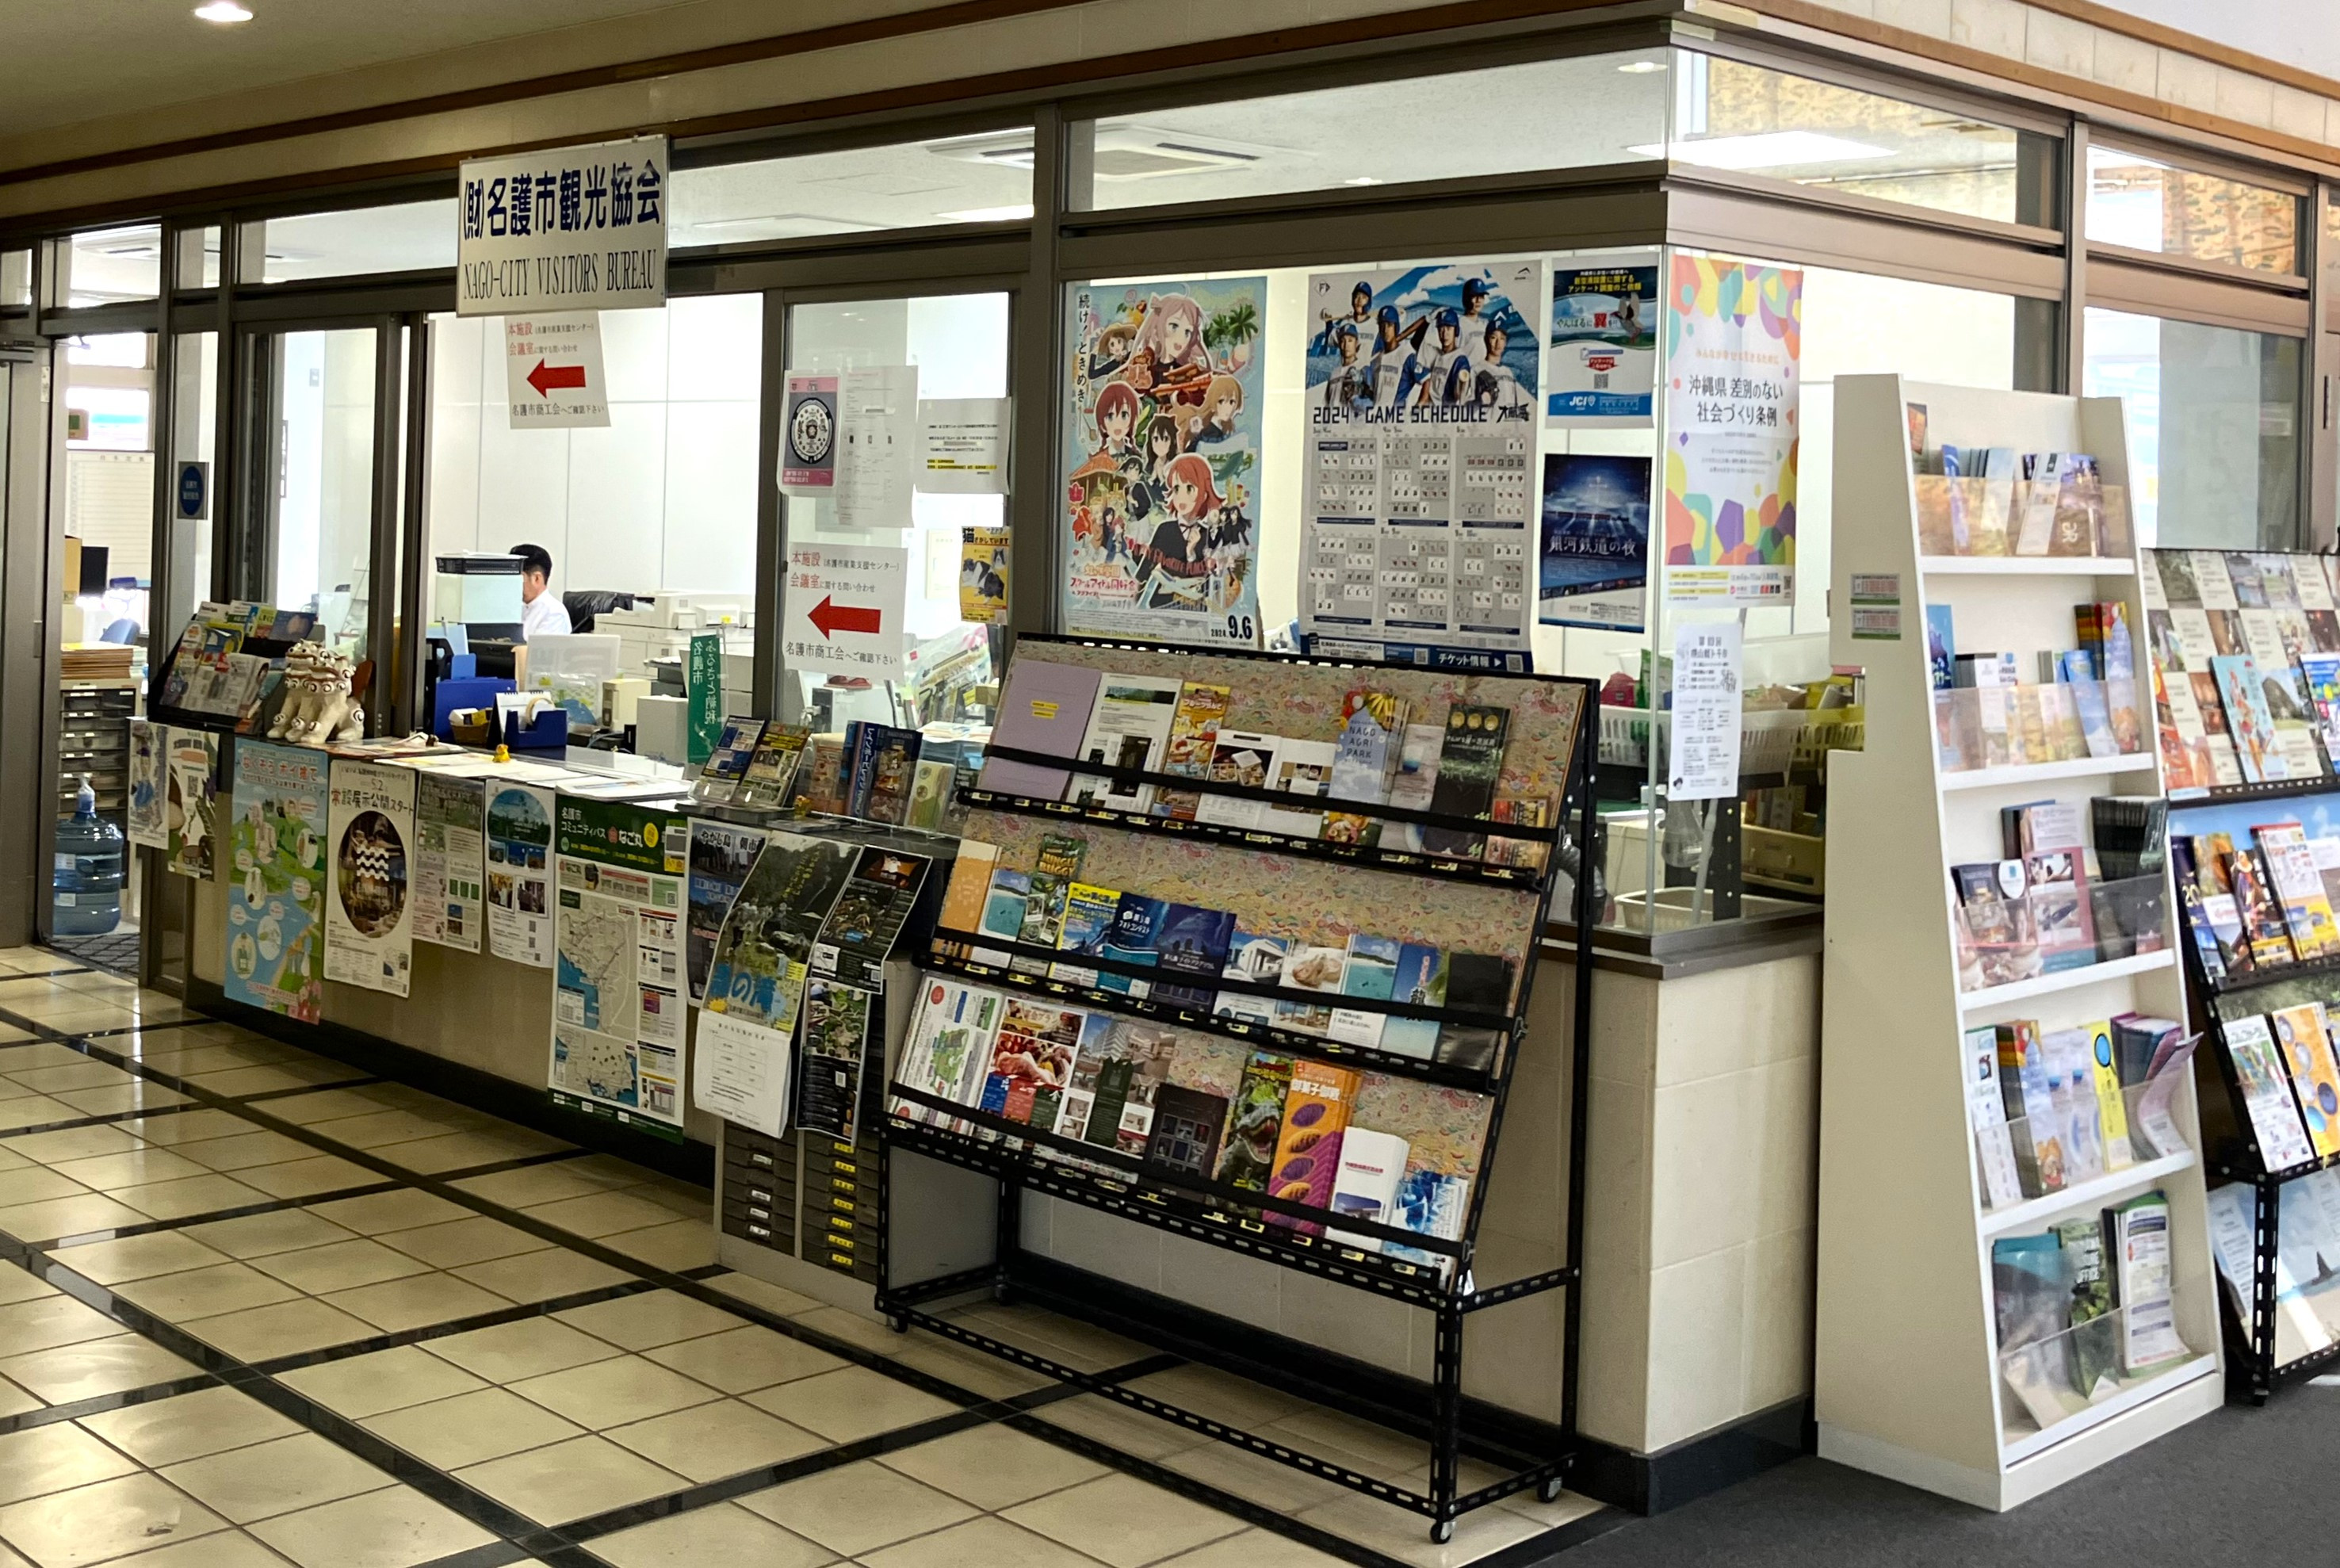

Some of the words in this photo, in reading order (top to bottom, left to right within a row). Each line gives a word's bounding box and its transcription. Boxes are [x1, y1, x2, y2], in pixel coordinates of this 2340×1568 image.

[464, 258, 530, 300] NAGO-CITY
[537, 252, 598, 296] VISITORS
[606, 249, 656, 291] BUREAU
[507, 323, 533, 336] 本施設
[1688, 374, 1727, 397] 沖縄県
[1730, 377, 1784, 400] 差別のない
[1570, 396, 1588, 407] JCI
[1313, 407, 1348, 424] 2024
[1366, 405, 1405, 423] GAME
[1411, 403, 1487, 423] SCHEDULE
[1697, 400, 1777, 427] 社会づくり条例
[1548, 535, 1636, 556] 銀河鉄道の夜
[792, 550, 820, 567] 本施設
[1229, 615, 1253, 640] 9.6
[786, 641, 897, 665] 名護市商工会へご確認下さい
[1439, 652, 1490, 668] チケット情報
[1349, 725, 1376, 736] NAGO
[1349, 738, 1374, 748] AGRI
[1347, 748, 1373, 759] PARK
[331, 787, 415, 817] 常設展示公開スタート
[561, 806, 582, 820] 名護市
[561, 821, 606, 839] コミュニティバス
[618, 828, 644, 848] なご丸
[1039, 862, 1076, 877] BUGGY
